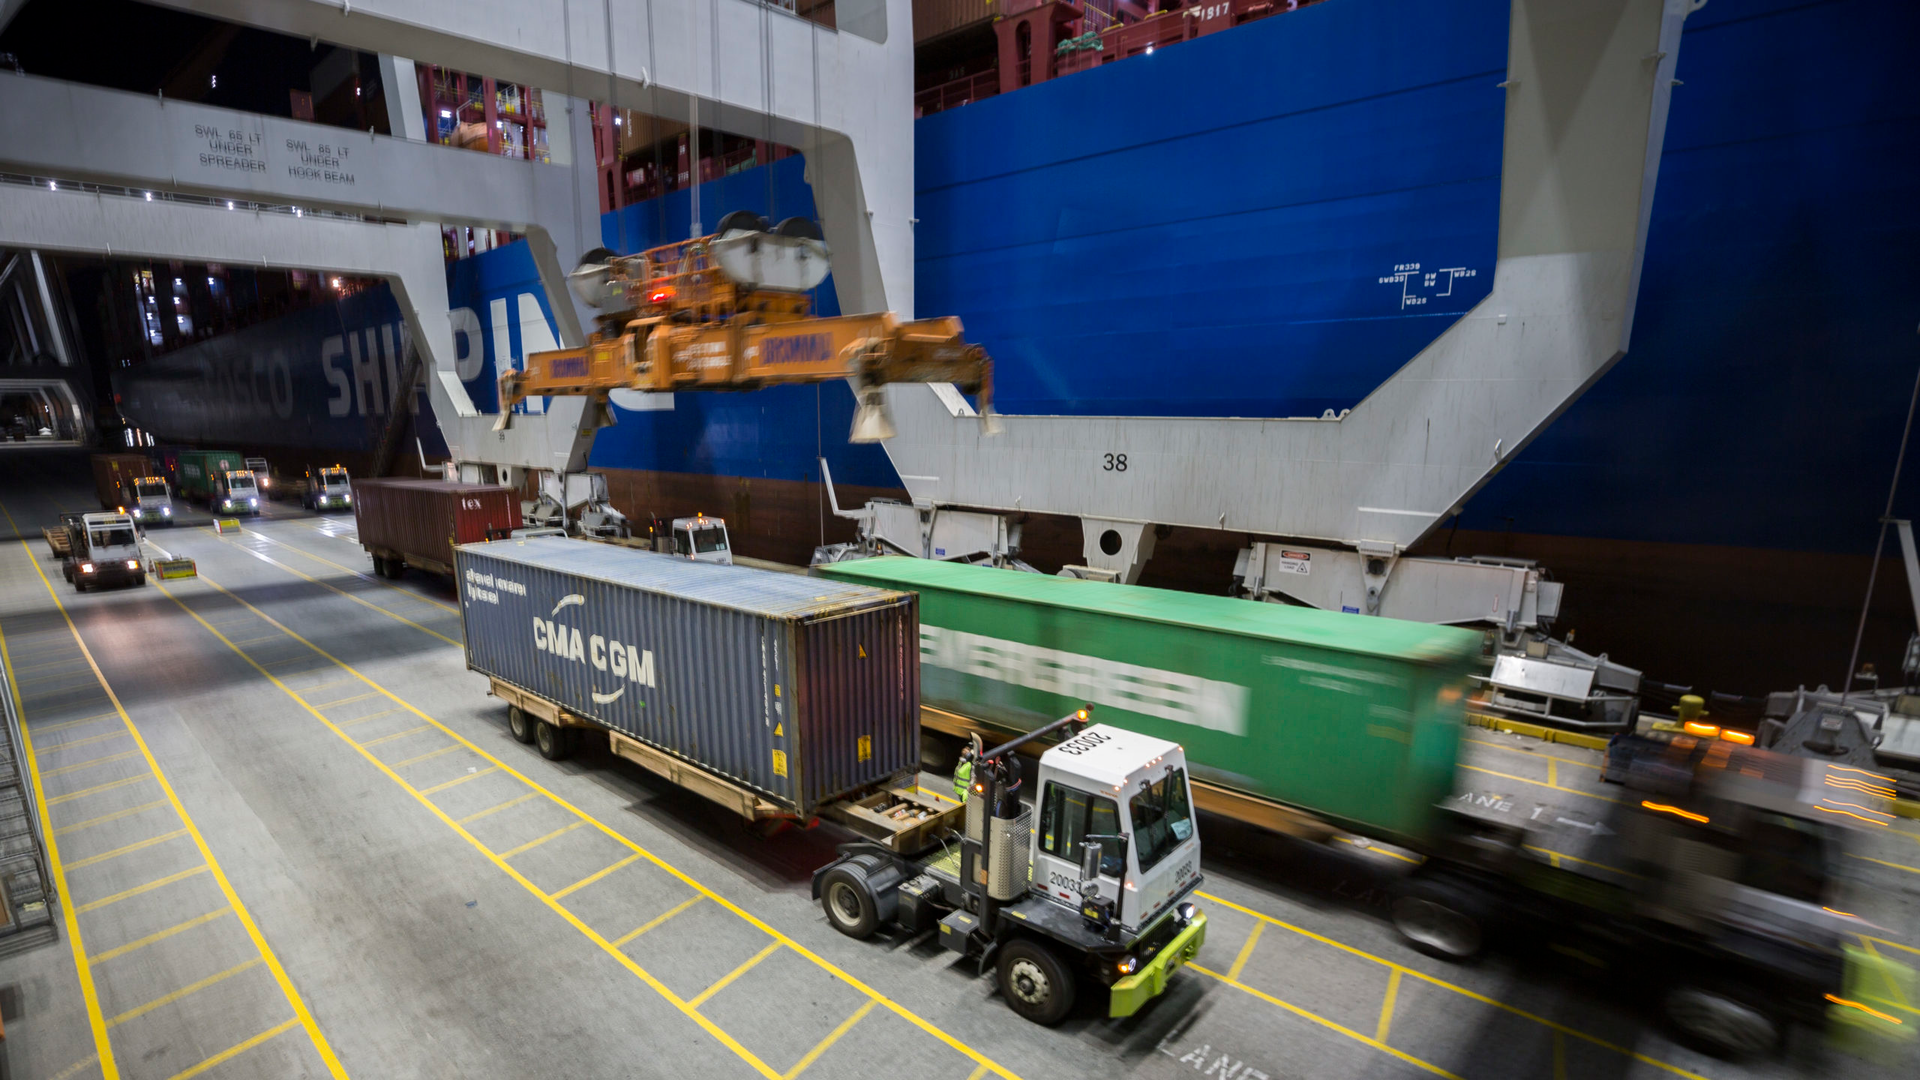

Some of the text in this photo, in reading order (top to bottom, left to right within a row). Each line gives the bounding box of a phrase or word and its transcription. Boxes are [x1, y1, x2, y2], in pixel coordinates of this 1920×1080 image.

[195, 124, 222, 139] SWL
[249, 133, 262, 146] LT
[209, 140, 253, 156] UNDER
[286, 139, 311, 152] SWL
[338, 147, 350, 159] LT
[199, 153, 267, 173] SPREADER
[301, 154, 340, 169] UNDER
[288, 165, 355, 186] HOOK BEAM
[1103, 453, 1128, 472] 38
[533, 616, 656, 689] CMA CGM
[1058, 732, 1112, 756] 20033
[1457, 792, 1543, 820] ANE 1
